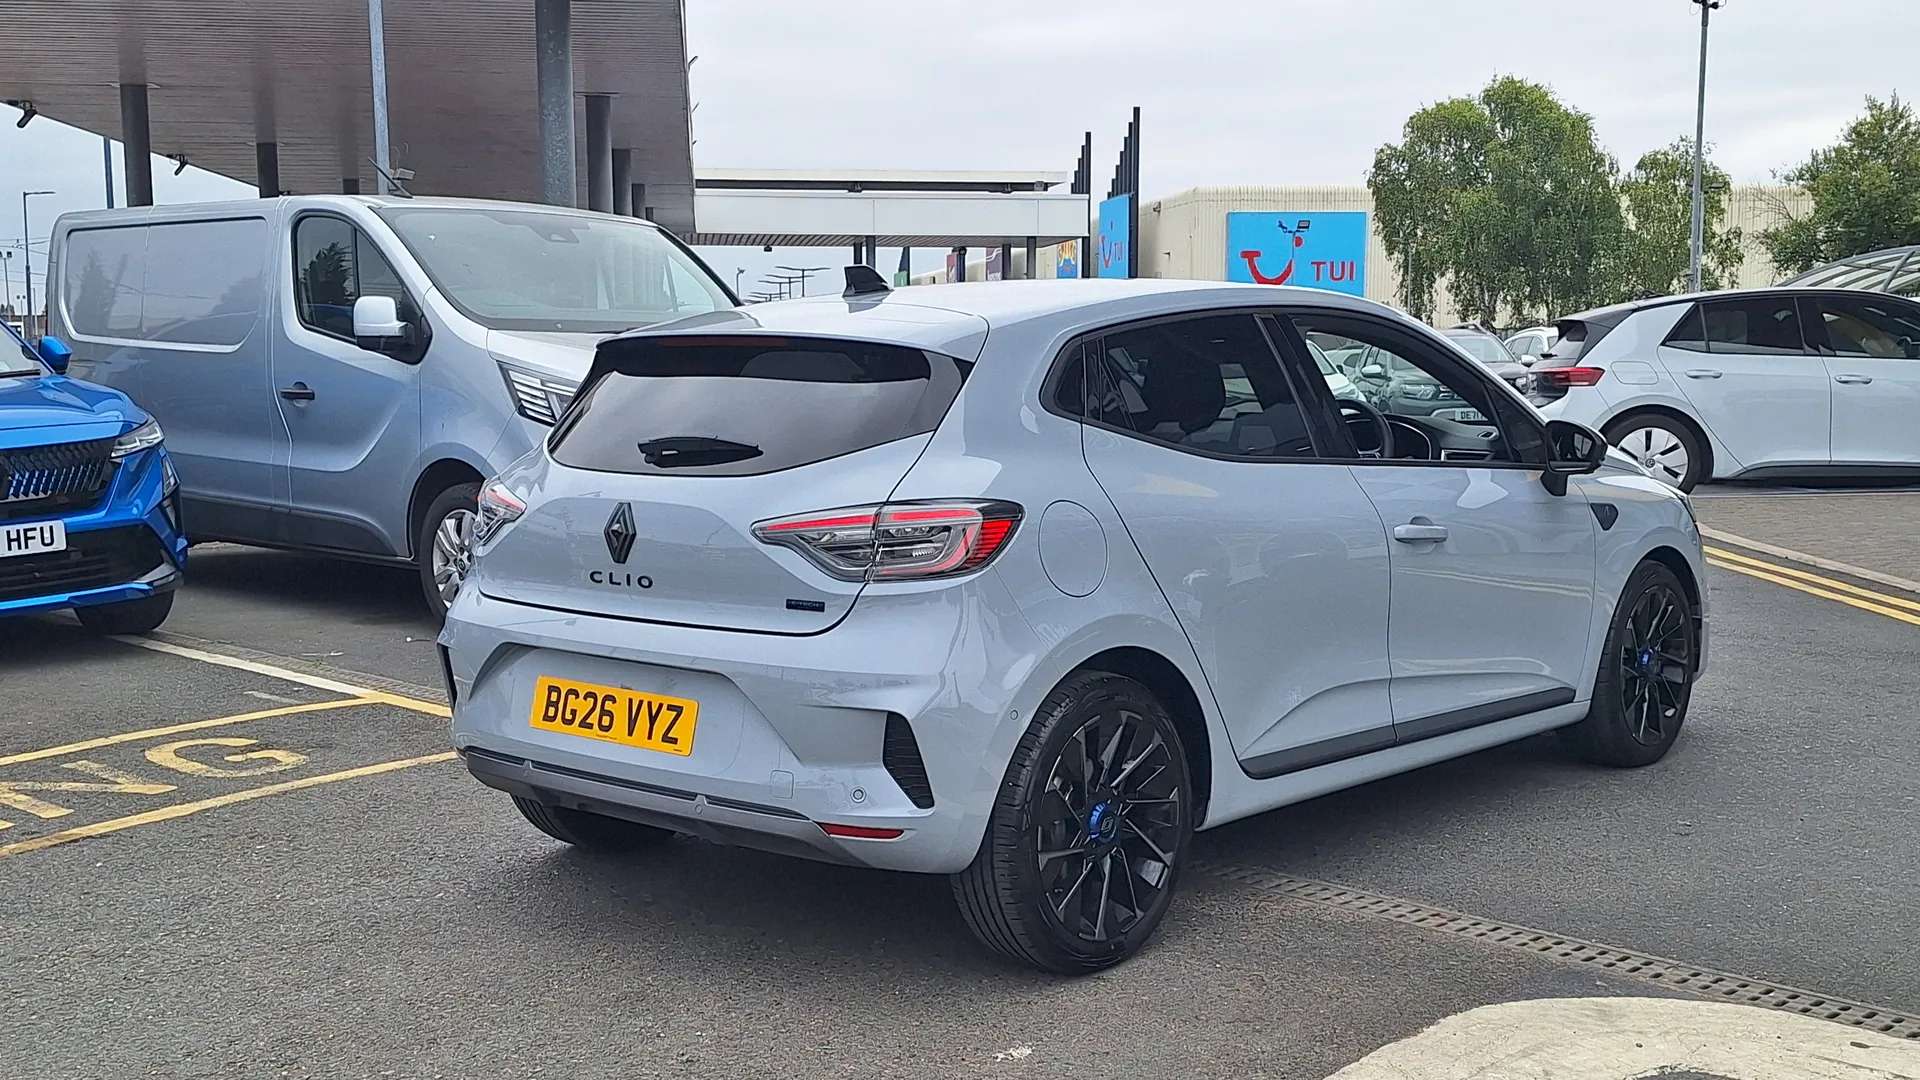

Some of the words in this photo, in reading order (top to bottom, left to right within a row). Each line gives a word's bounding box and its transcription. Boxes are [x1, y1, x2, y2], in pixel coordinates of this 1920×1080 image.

[1311, 261, 1355, 281] TUI
[6, 525, 55, 551] HFU
[589, 570, 653, 589] CLIO
[542, 684, 617, 733] BG26
[627, 697, 684, 745] VYZ
[0, 737, 309, 828] NG
